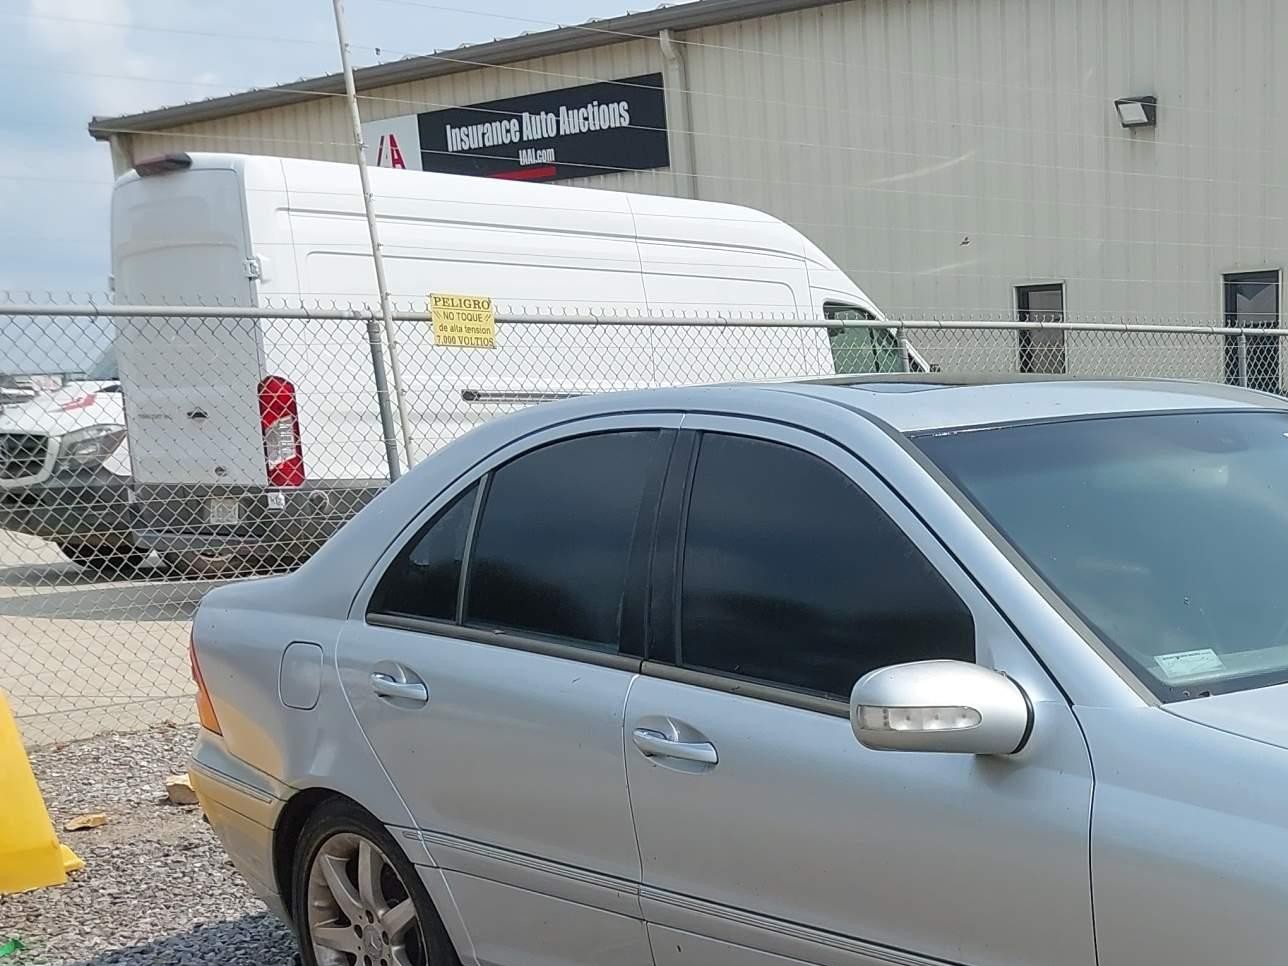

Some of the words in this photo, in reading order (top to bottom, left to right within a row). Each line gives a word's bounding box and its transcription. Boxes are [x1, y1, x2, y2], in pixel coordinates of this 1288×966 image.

[445, 118, 521, 152] Insurance
[522, 111, 558, 141] Auto
[559, 100, 631, 136] Auctions
[518, 148, 556, 166] IAAI.com
[433, 296, 491, 310] PELIGRO
[443, 311, 455, 321] NO
[457, 312, 484, 323] TOQUE
[438, 324, 448, 332] de
[449, 324, 463, 333] alta
[458, 335, 494, 347] VOLTIOS
